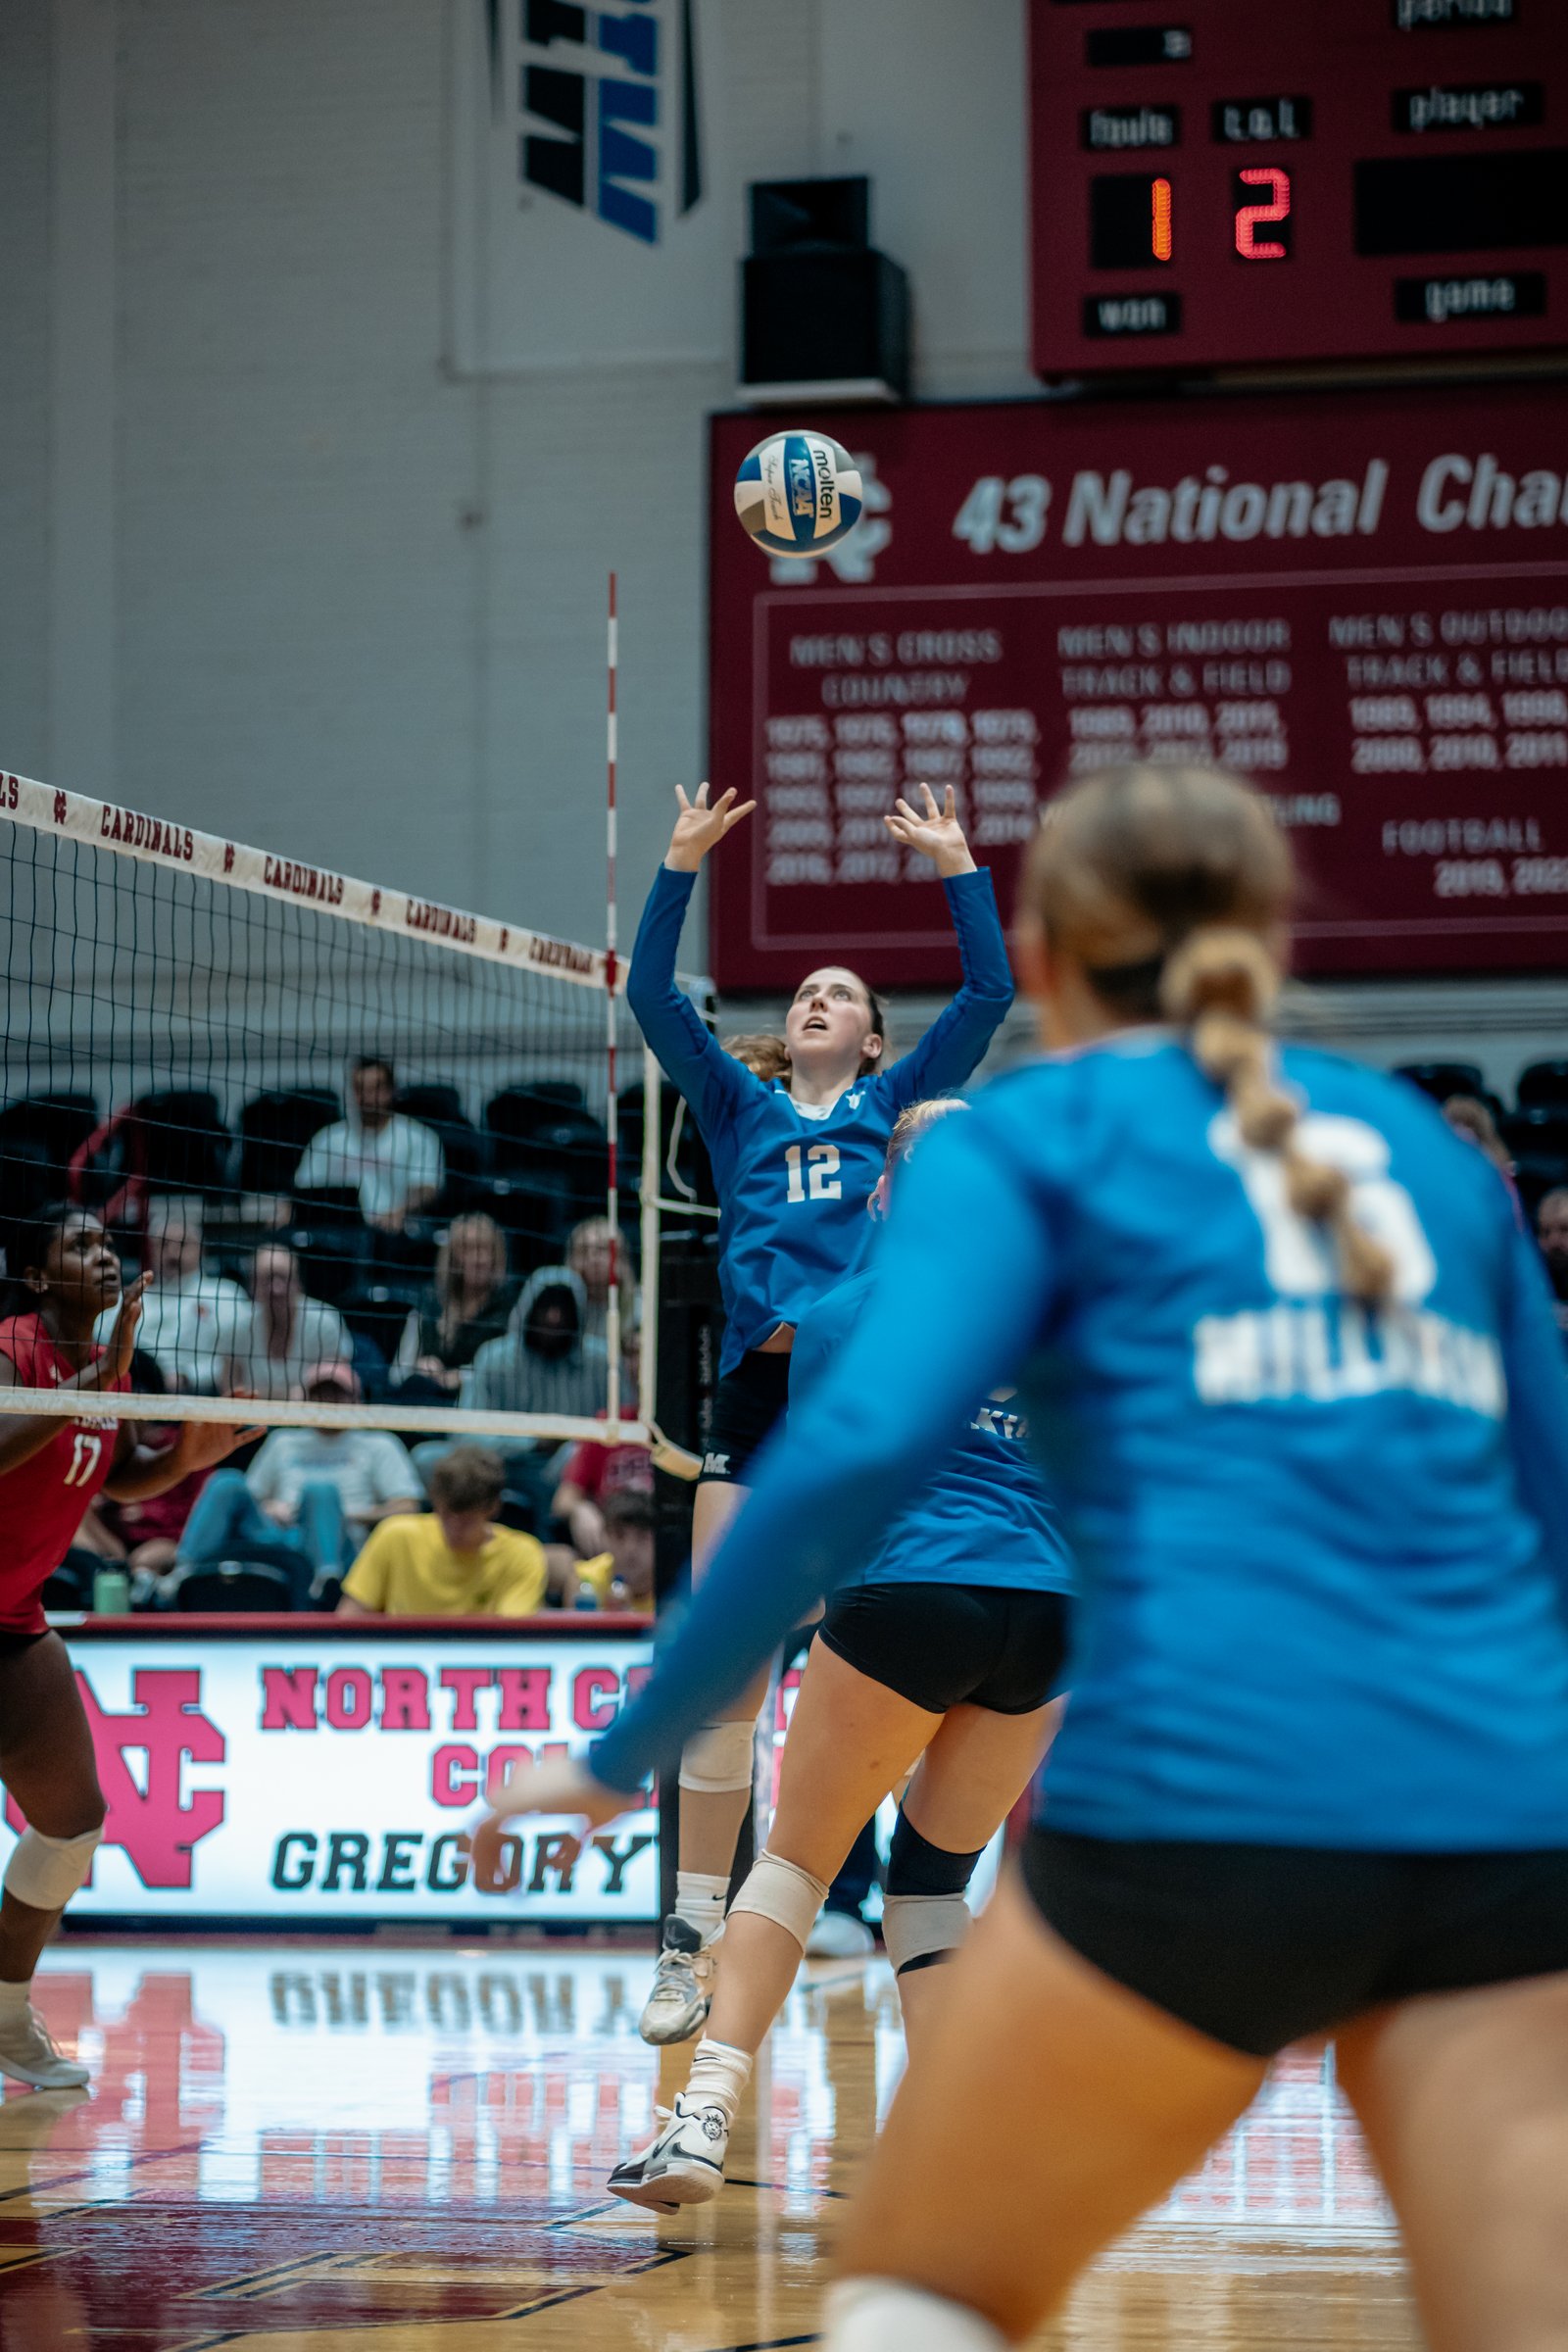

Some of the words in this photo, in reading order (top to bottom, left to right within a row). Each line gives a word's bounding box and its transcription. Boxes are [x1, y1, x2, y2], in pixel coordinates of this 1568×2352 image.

[1410, 87, 1526, 132] player
[1152, 178, 1172, 261] 1
[1236, 168, 1291, 259] 2
[1098, 298, 1167, 332] won
[1425, 277, 1517, 322] game
[788, 459, 813, 518] NCAA
[812, 450, 835, 518] molten
[953, 473, 1053, 555] 43
[1062, 461, 1388, 547] National
[1417, 454, 1568, 532] Cha
[897, 630, 1001, 664] CROSS
[1167, 619, 1291, 656] INDOOR
[822, 671, 967, 708] COUNTRY
[1063, 665, 1160, 699] TRACK
[1170, 664, 1196, 698] &
[1202, 661, 1292, 695] FIELD
[1348, 655, 1447, 688] TRACK
[1456, 652, 1482, 685] &
[100, 804, 194, 861] CARDINALS
[264, 856, 344, 906] CARDINALS
[1382, 817, 1541, 856] FOOTBALL
[785, 1145, 842, 1203] 12
[63, 1433, 102, 1488] 17
[261, 1667, 553, 1732] NORTH
[270, 1832, 655, 1896] GREGORY
